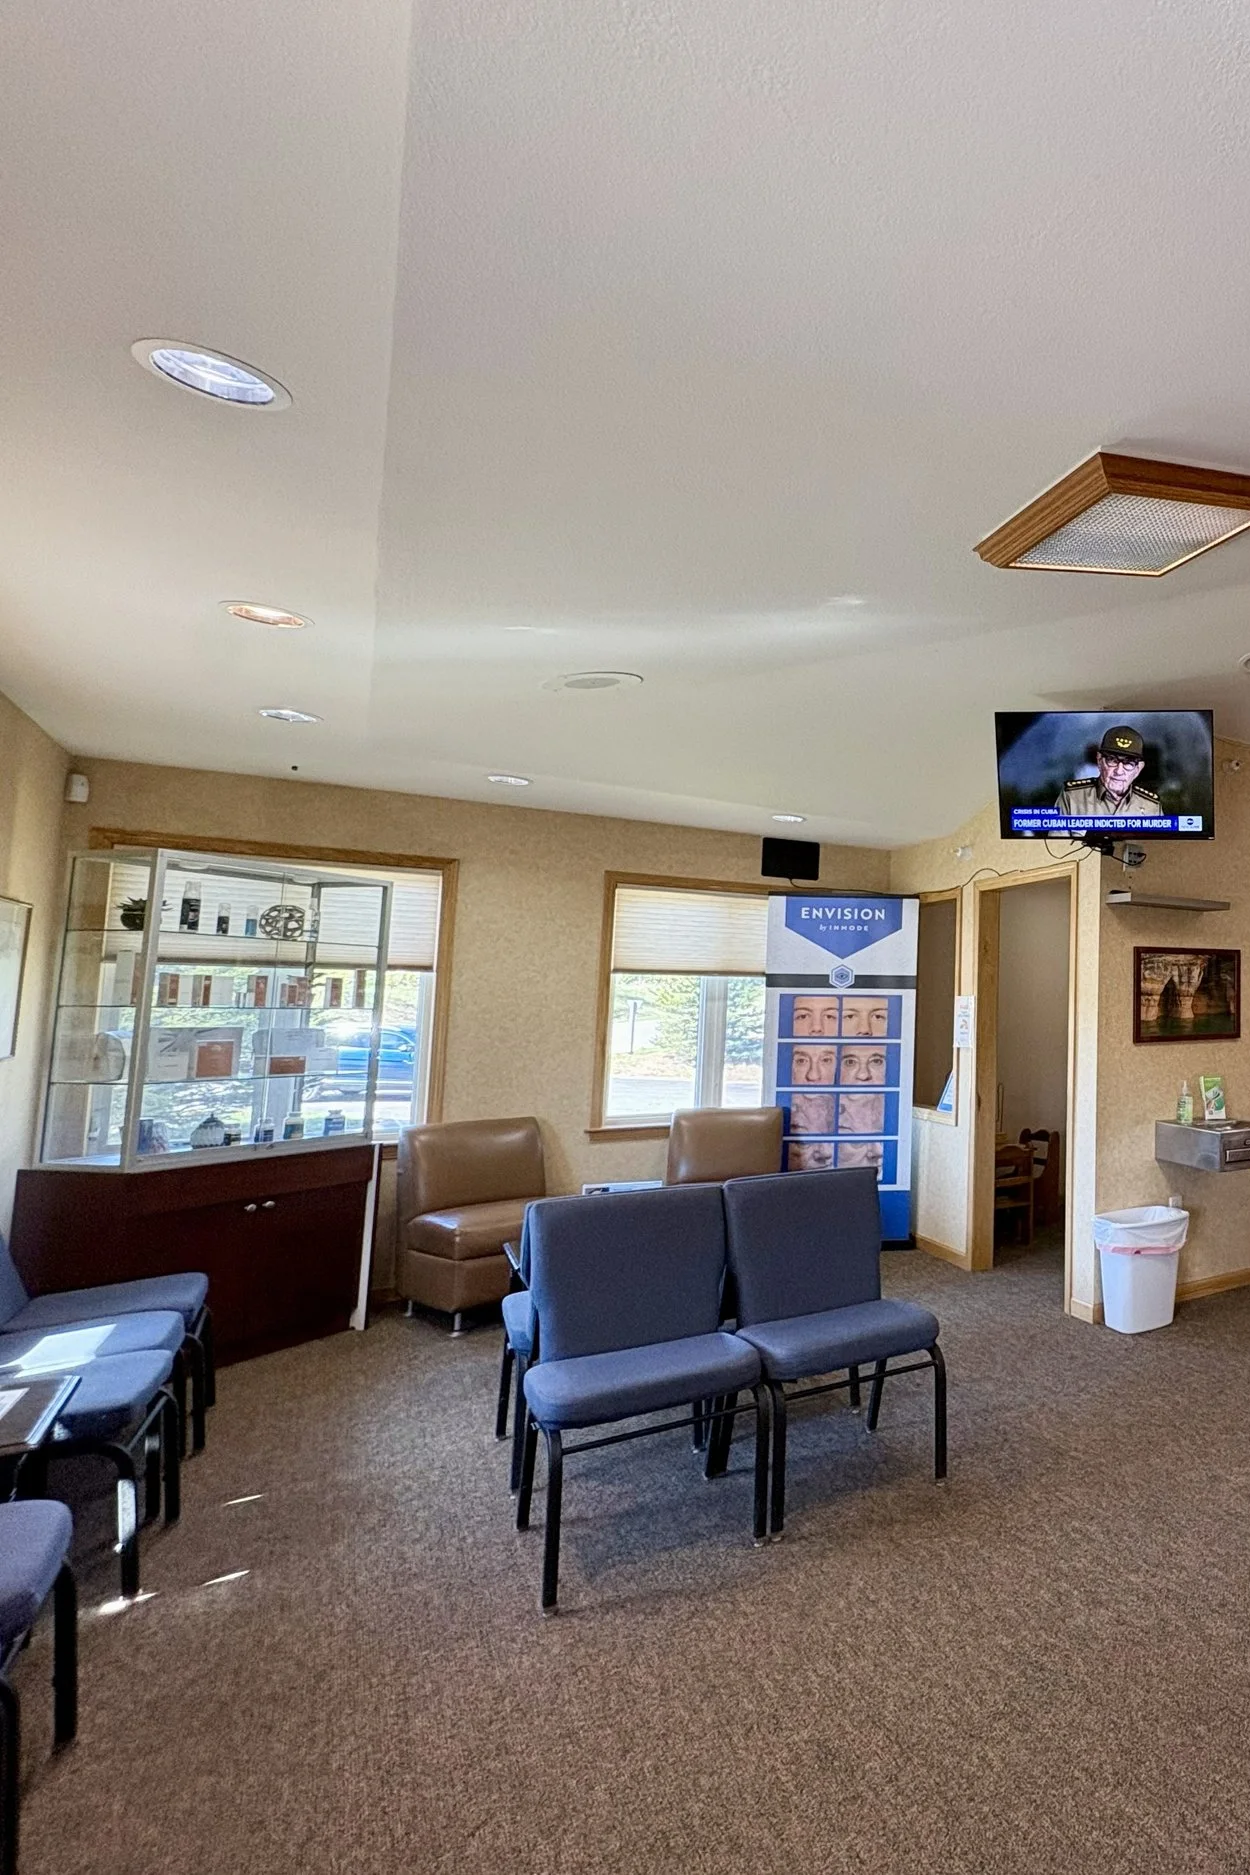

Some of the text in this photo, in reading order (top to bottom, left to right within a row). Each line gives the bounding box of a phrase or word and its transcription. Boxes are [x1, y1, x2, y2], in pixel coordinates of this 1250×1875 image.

[1013, 818, 1041, 828] FORMER
[1042, 818, 1066, 828] CUBAN
[1067, 818, 1093, 828] LEADER
[1094, 818, 1126, 828] INDICTED
[1127, 818, 1141, 828] FOR
[1142, 819, 1171, 828] MURDER
[801, 907, 885, 920] ENVISION
[819, 924, 827, 932] by
